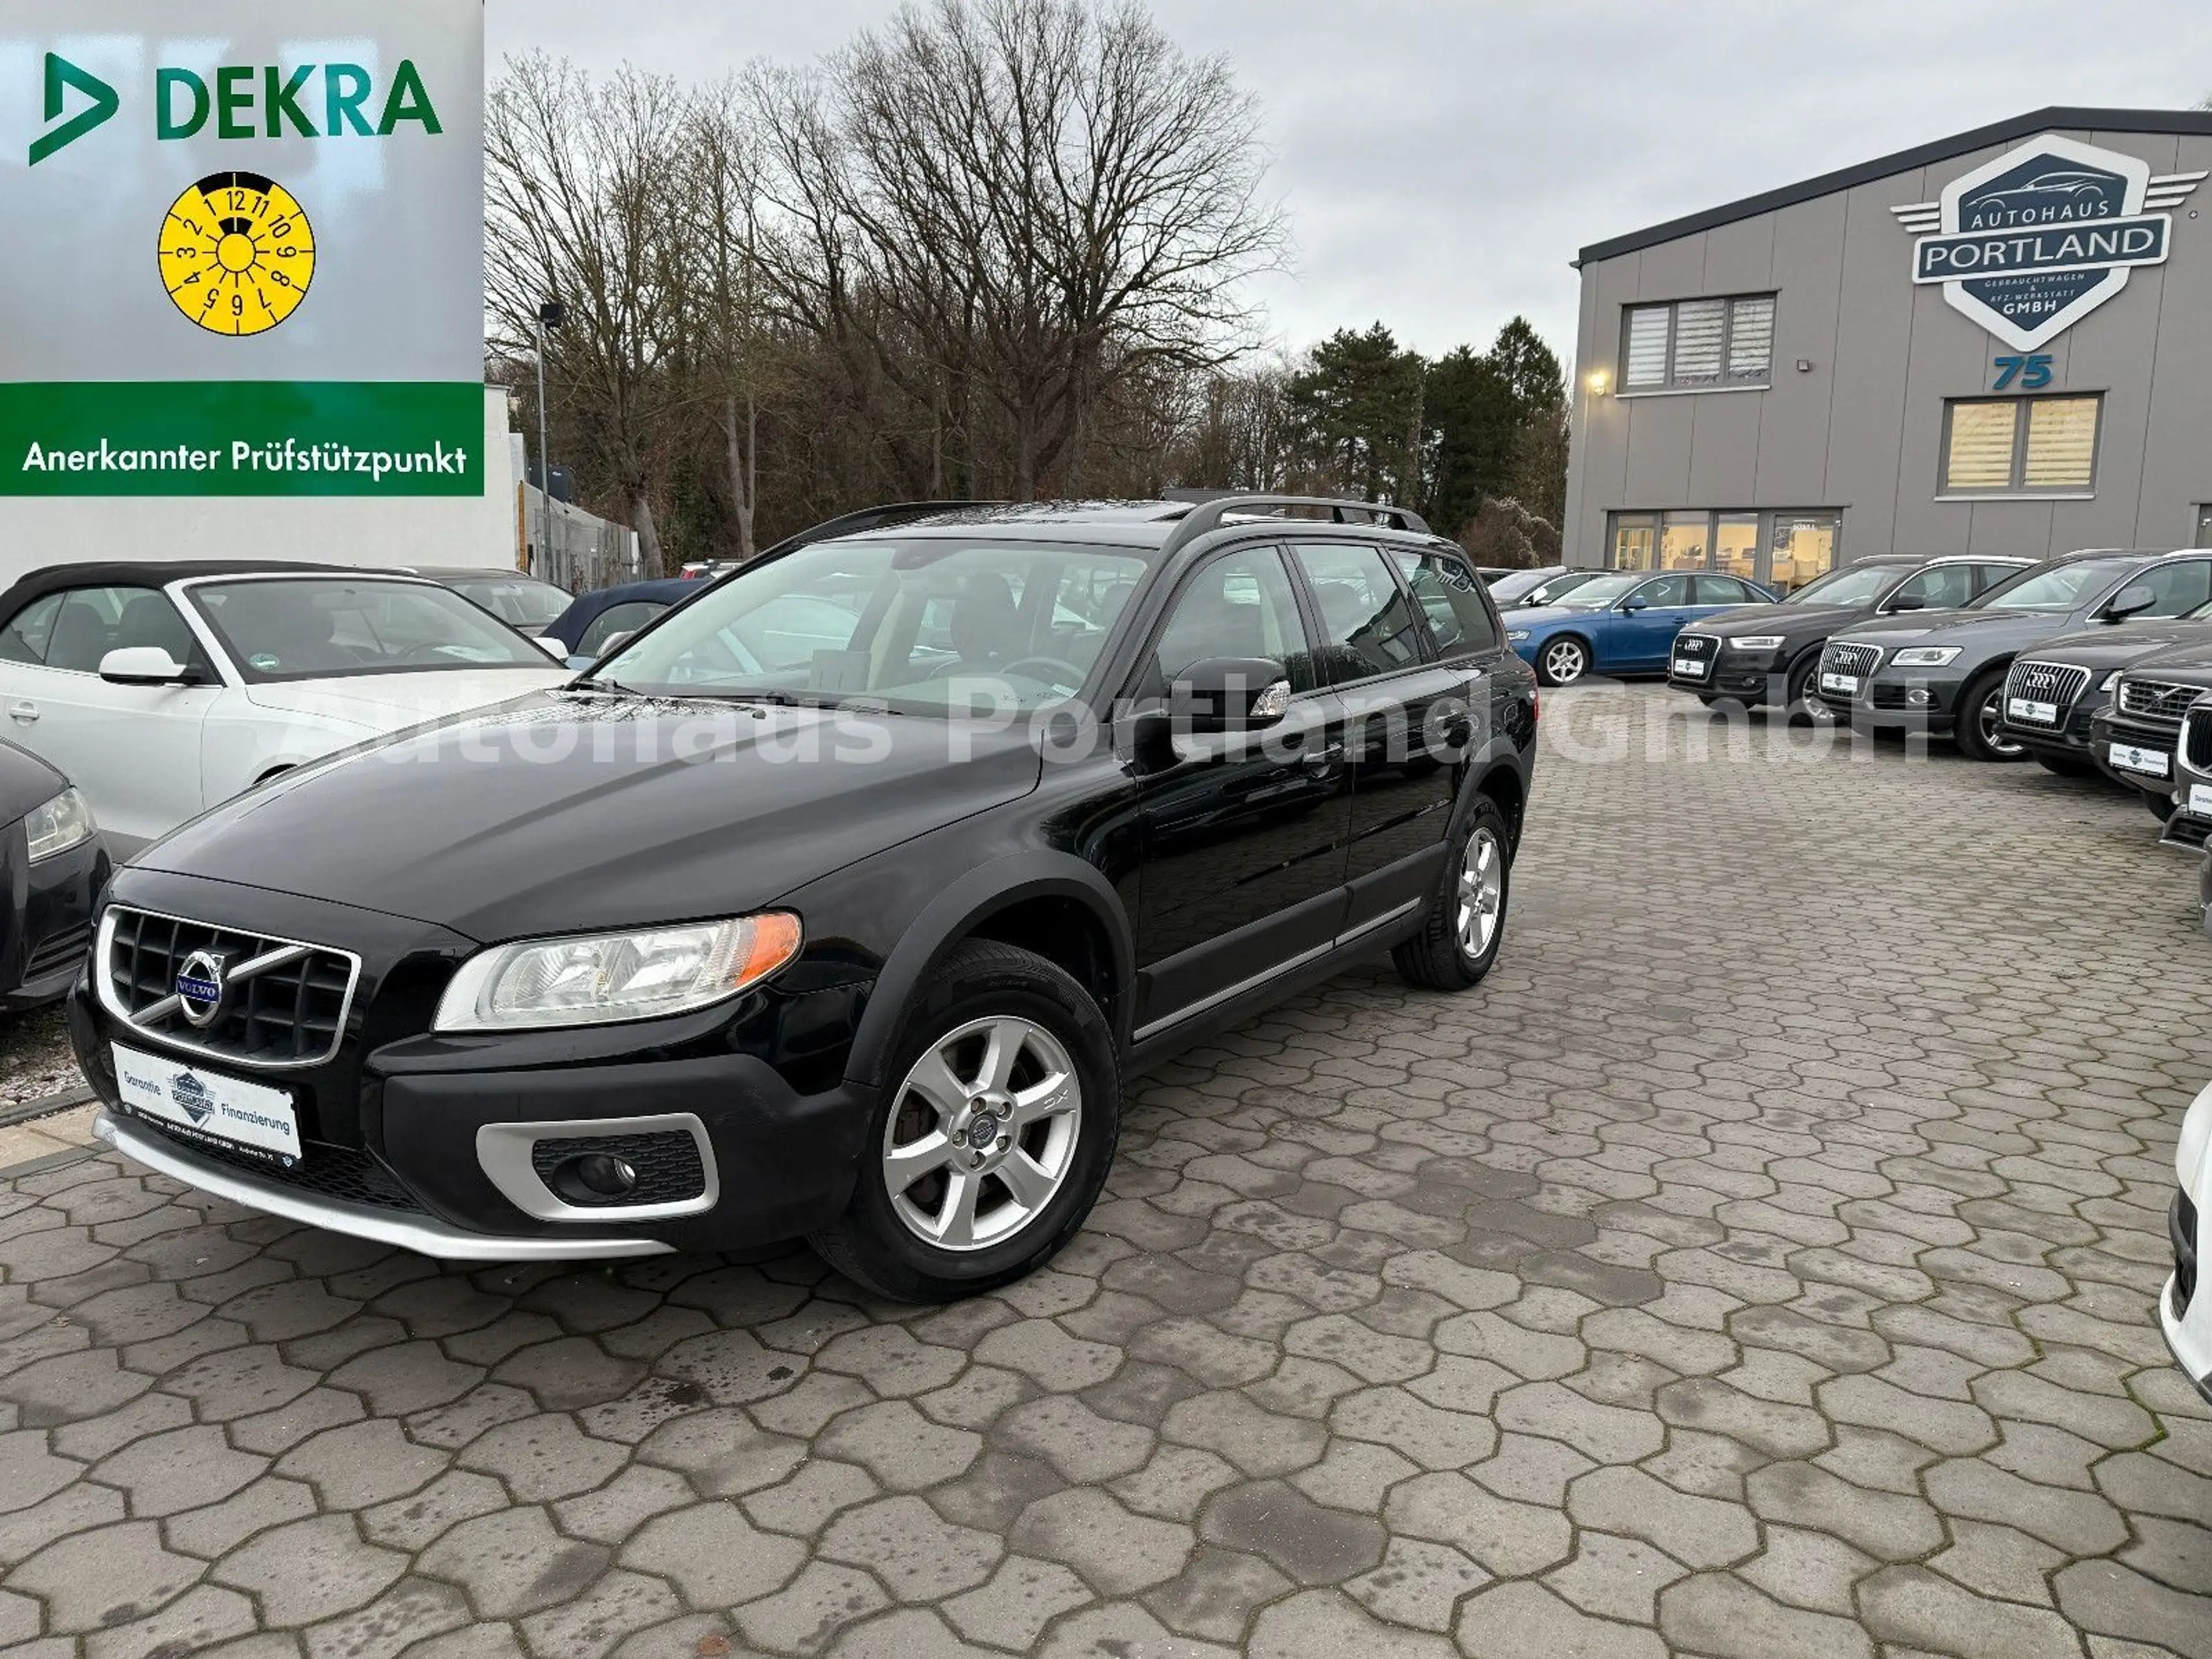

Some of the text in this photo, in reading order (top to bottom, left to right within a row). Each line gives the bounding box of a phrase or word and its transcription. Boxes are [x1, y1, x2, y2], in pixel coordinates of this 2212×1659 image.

[1971, 200, 2109, 229] AUTOHAUS
[1925, 228, 2154, 271] PORTLAND
[1984, 273, 2085, 287] GEBRAUCHTWAGEN
[1990, 289, 2075, 302] KFZ-WERKSTATT
[2002, 300, 2057, 315] GMBH
[1993, 354, 2054, 389] 75
[177, 979, 216, 998] VOLVO
[221, 1103, 290, 1136] Finanzierung
